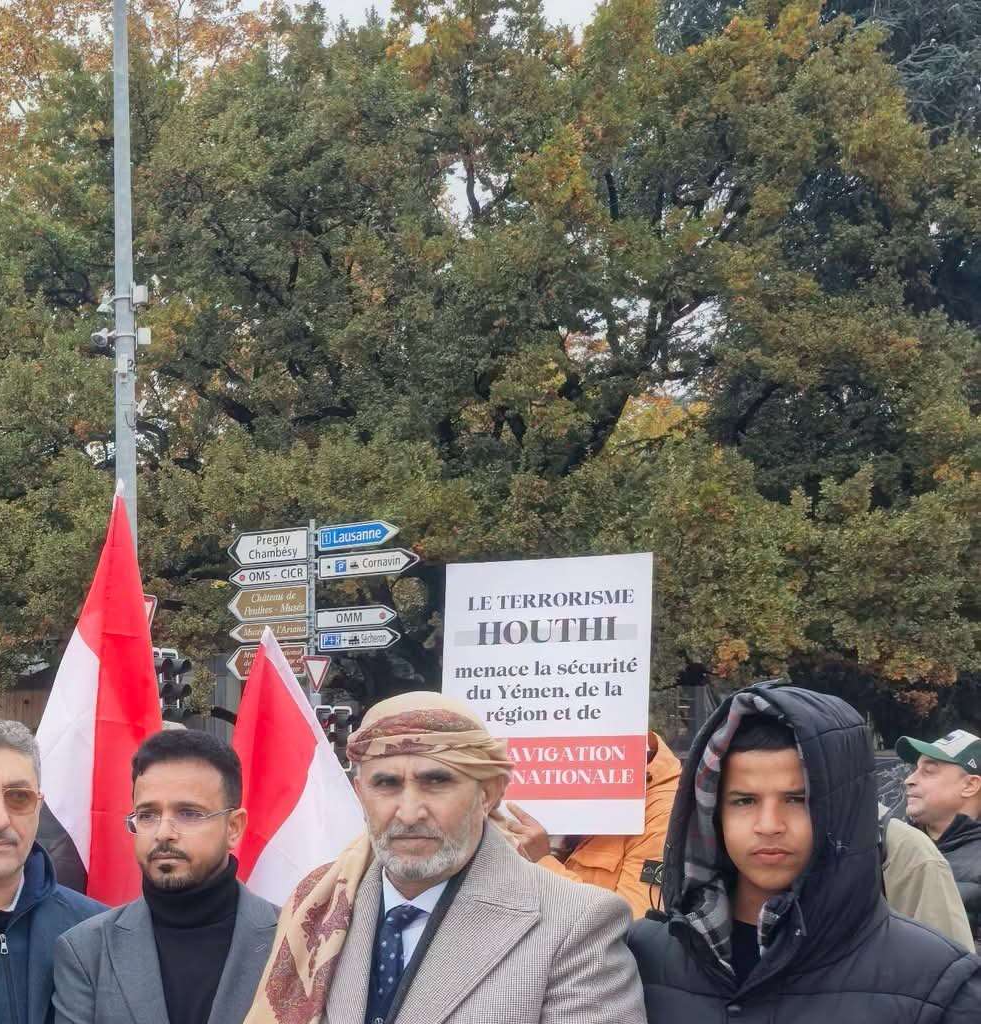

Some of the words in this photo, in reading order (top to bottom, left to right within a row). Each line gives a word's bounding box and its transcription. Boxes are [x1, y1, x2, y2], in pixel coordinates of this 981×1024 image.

[257, 535, 290, 546] Pregny
[333, 527, 382, 544] Lausanne
[362, 556, 401, 569] Cornavin
[249, 572, 270, 582] OMS
[280, 568, 303, 580] CICR
[468, 596, 491, 612] LE
[497, 589, 634, 611] TERRORISME
[336, 612, 363, 623] OMM
[477, 616, 617, 646] HOUTHI
[455, 664, 529, 679] menace
[534, 661, 551, 676] la
[557, 657, 638, 675] sécurité
[466, 685, 491, 700] du
[575, 682, 599, 697] de
[605, 681, 622, 696] la
[486, 706, 547, 726] région
[553, 707, 571, 720] et
[577, 704, 601, 720] de
[506, 745, 626, 762] AVIGATION
[509, 768, 634, 785] NATIONALE
